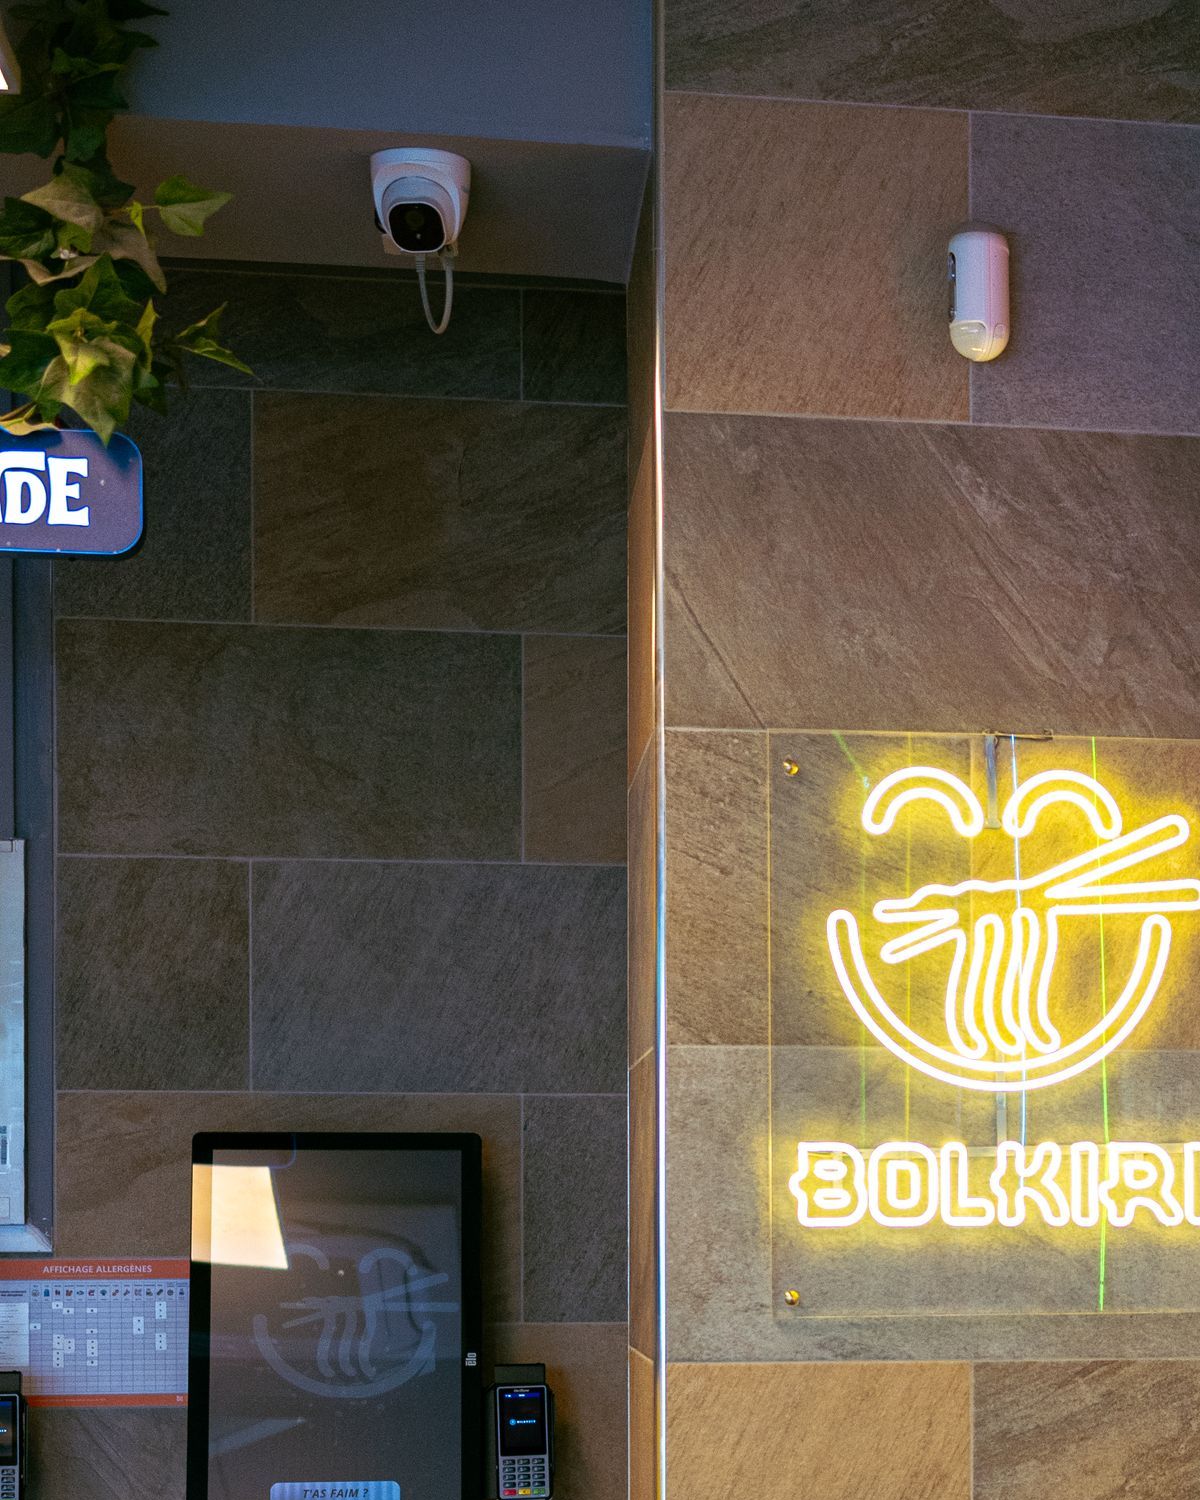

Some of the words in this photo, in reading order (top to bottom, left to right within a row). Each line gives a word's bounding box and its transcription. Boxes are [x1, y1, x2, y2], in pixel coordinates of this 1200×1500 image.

[42, 1265, 93, 1274] AFFICHAGE
[303, 1489, 326, 1498] T'AS
[330, 1488, 359, 1498] FAIM
[362, 1487, 369, 1498] ?
